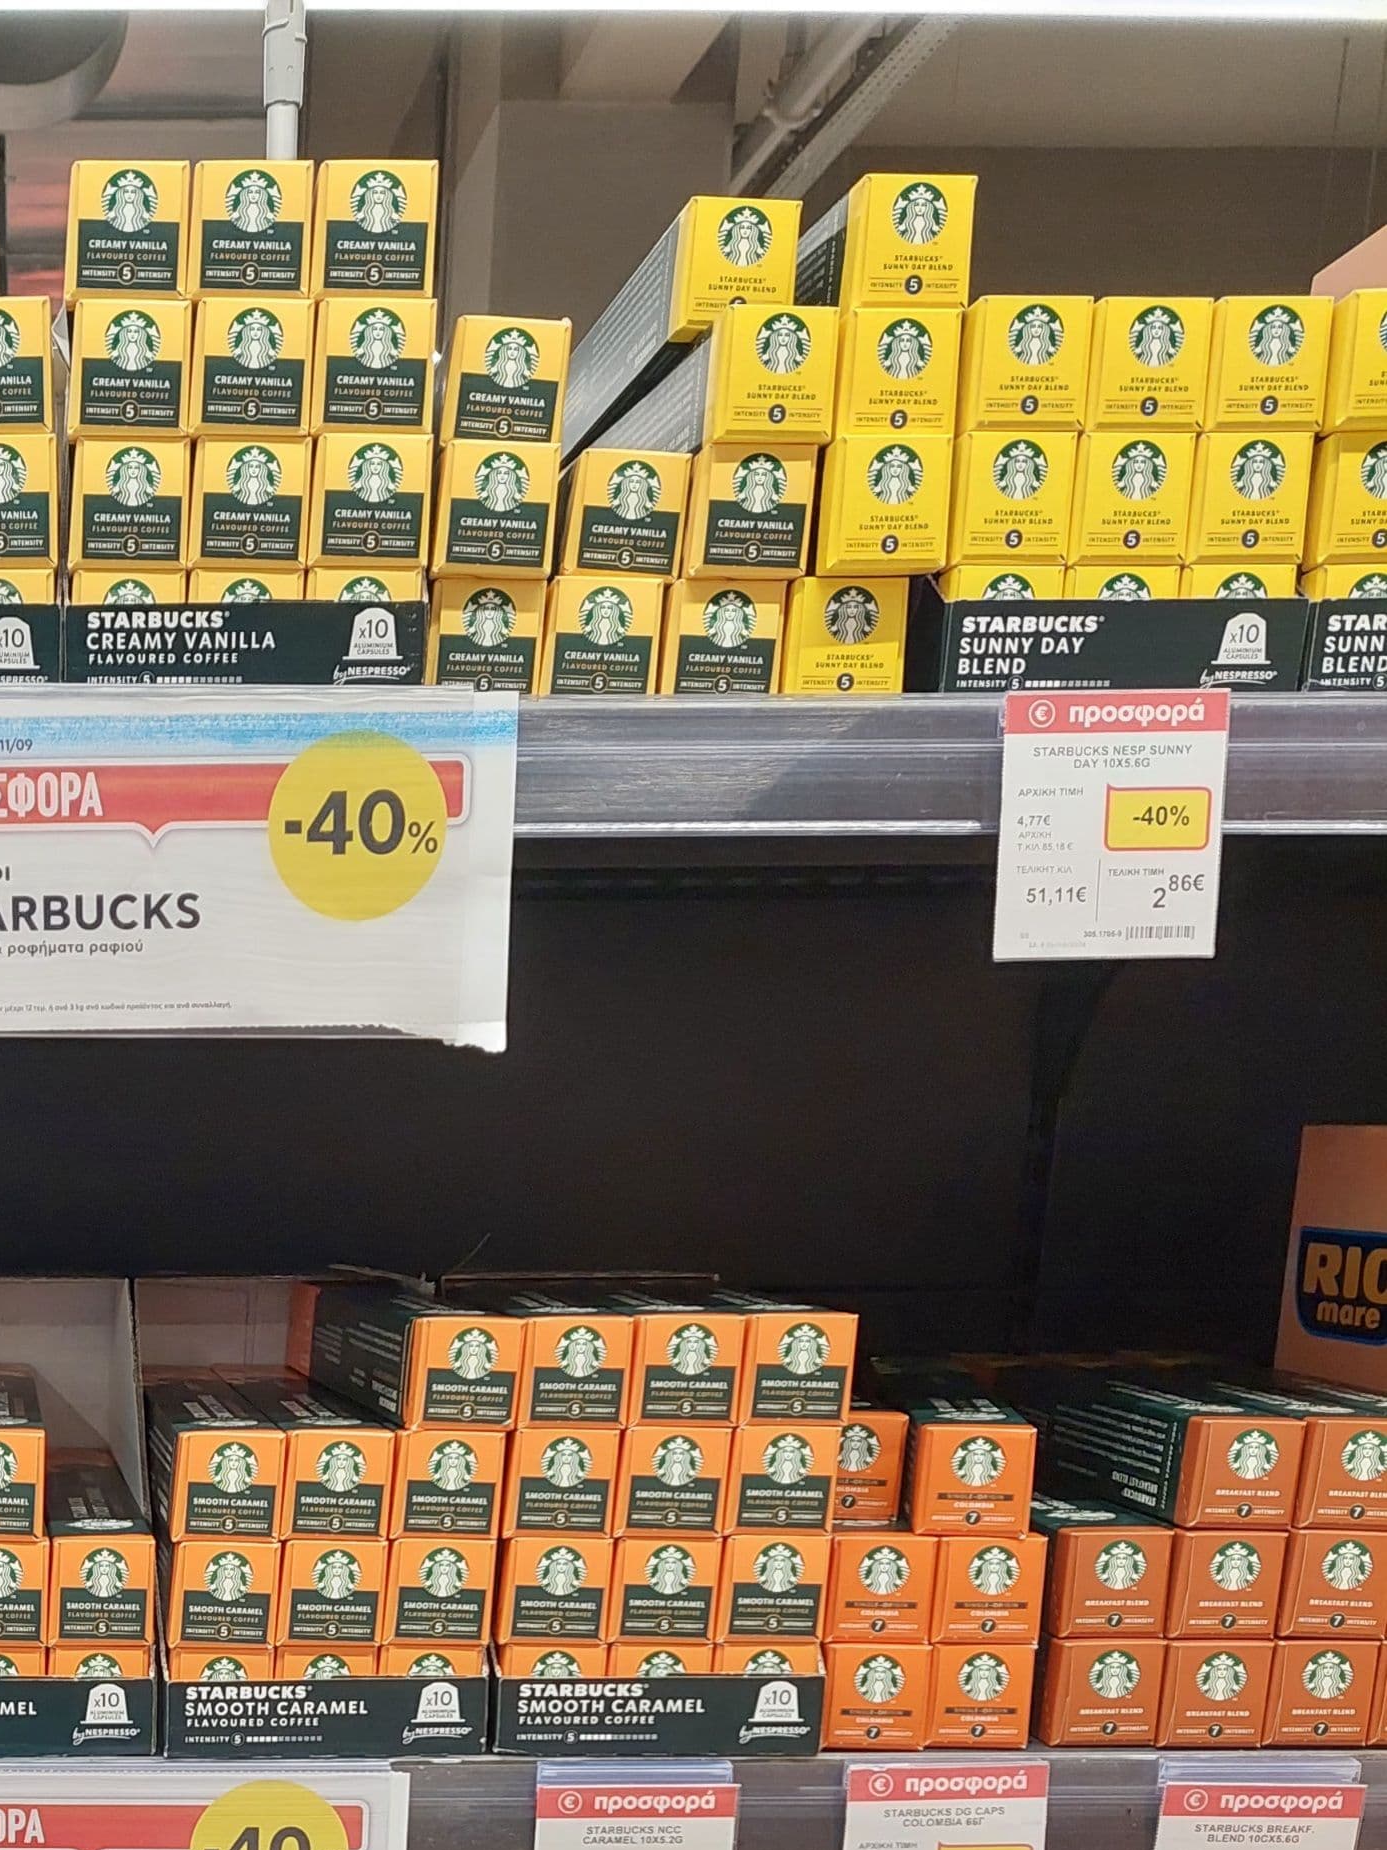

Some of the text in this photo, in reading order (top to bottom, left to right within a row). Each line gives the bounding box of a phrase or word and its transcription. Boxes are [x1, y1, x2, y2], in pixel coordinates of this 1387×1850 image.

[88, 239, 168, 251] CREAMY VANILLA
[87, 252, 167, 261] FLAVOURED COFFEE
[86, 612, 224, 629] STARBUCKS
[962, 615, 1097, 633] STARBUCKS
[86, 630, 276, 653] CREAMY VANILLA
[1229, 624, 1260, 644] x10
[960, 637, 1085, 654] SUNNY DAY
[958, 658, 1026, 675] BLEND
[1069, 698, 1205, 728] προσφορά
[0, 738, 33, 754] 11/09
[1033, 744, 1193, 757] STARBUCKS NESP SUNNY
[1074, 758, 1100, 769] DAY
[284, 788, 438, 858] -40%
[1017, 815, 1051, 828] 4,77€
[1132, 806, 1190, 828] -40%
[1026, 886, 1087, 905] 51,11€
[7, 940, 84, 958] ροφήματα
[89, 939, 144, 956] ραφιού
[1317, 1301, 1381, 1328] mare
[906, 1770, 1028, 1794] προσφορά
[594, 1790, 716, 1813] προσφορά
[1220, 1791, 1343, 1813] προσφορά
[1194, 1824, 1263, 1833] STARBUCKS
[1207, 1834, 1244, 1843] BLEND
